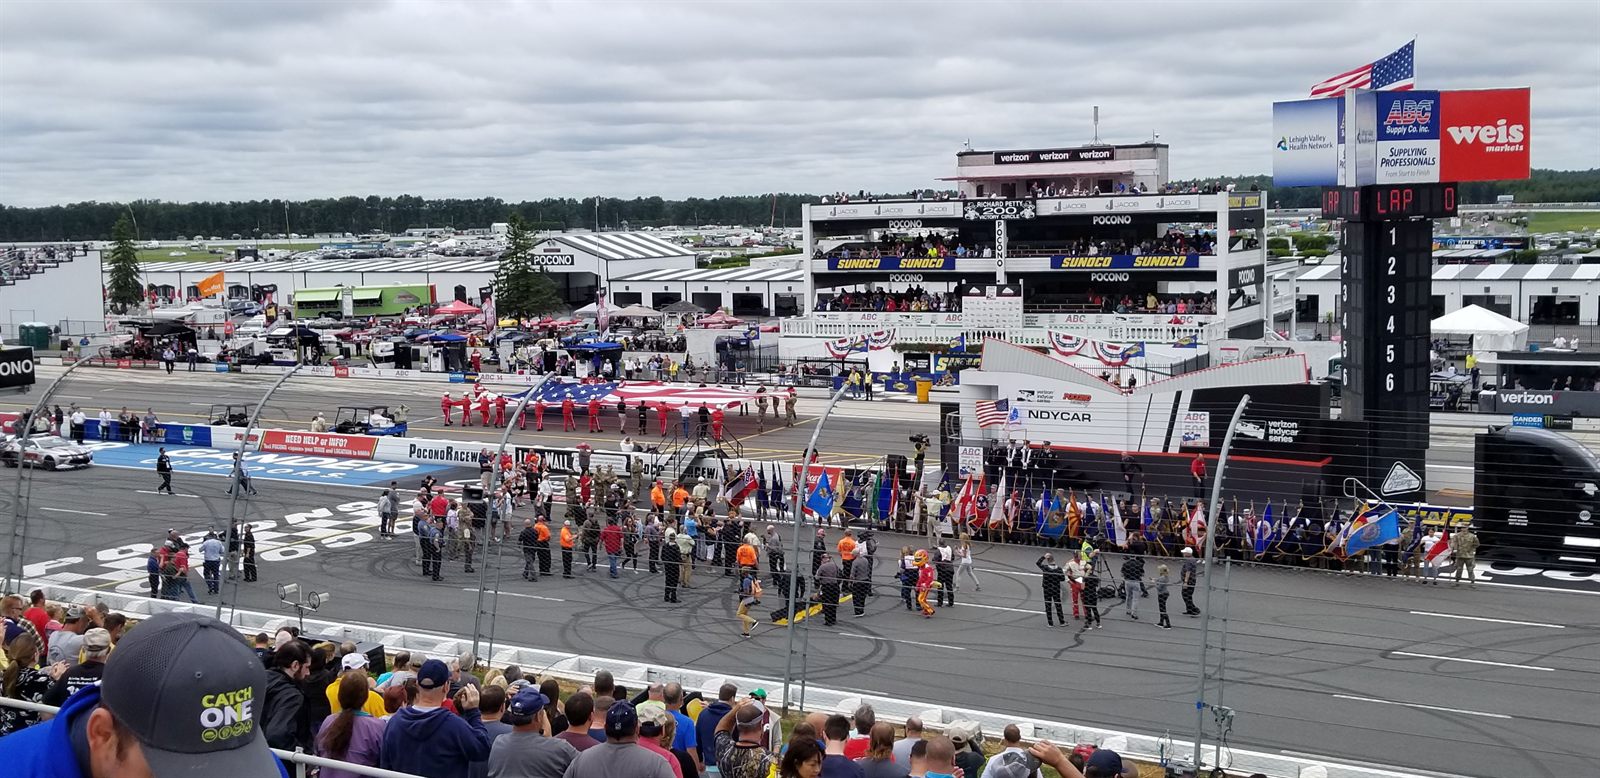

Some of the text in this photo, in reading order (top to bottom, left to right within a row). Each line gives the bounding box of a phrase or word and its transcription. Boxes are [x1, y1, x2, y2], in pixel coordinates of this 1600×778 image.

[1384, 100, 1434, 125] ABC
[1386, 124, 1430, 136] Supply Co. Inc.
[1446, 119, 1524, 144] weis
[1308, 134, 1326, 142] Valley
[1308, 142, 1334, 150] Network
[1486, 144, 1524, 152] markets
[1000, 154, 1030, 162] verizon
[1040, 152, 1068, 160] verizon
[1080, 150, 1110, 159] verizon
[1390, 147, 1427, 158] SUPPLYING
[1380, 158, 1436, 168] PROFESSIONALS
[1322, 191, 1339, 214] LAP
[1377, 188, 1454, 214] LAP 0
[982, 206, 1017, 215] 200
[889, 220, 922, 228] POCONO
[1093, 216, 1131, 224] POCONO
[1390, 227, 1396, 246] 1
[534, 256, 572, 265] POCONO
[837, 258, 881, 269] SUNOCO
[899, 258, 945, 268] SUNOCO
[1062, 256, 1112, 268] SUNOCO
[1134, 256, 1187, 266] SUNOCO
[1388, 256, 1396, 275] 2
[889, 274, 923, 282] POCONO
[1091, 272, 1129, 282] POCONO
[1387, 285, 1396, 304] 3
[1386, 315, 1395, 333] 4
[1386, 345, 1394, 363] 5
[1386, 373, 1394, 391] 6
[1501, 392, 1553, 404] verizon
[1268, 420, 1297, 429] verizon
[1269, 428, 1299, 436] indycar
[285, 434, 302, 444] NEED
[303, 436, 320, 445] HELP
[329, 437, 348, 447] INFO?
[545, 452, 572, 470] WALL
[202, 686, 252, 708] CATCH
[200, 700, 252, 728] ONE
